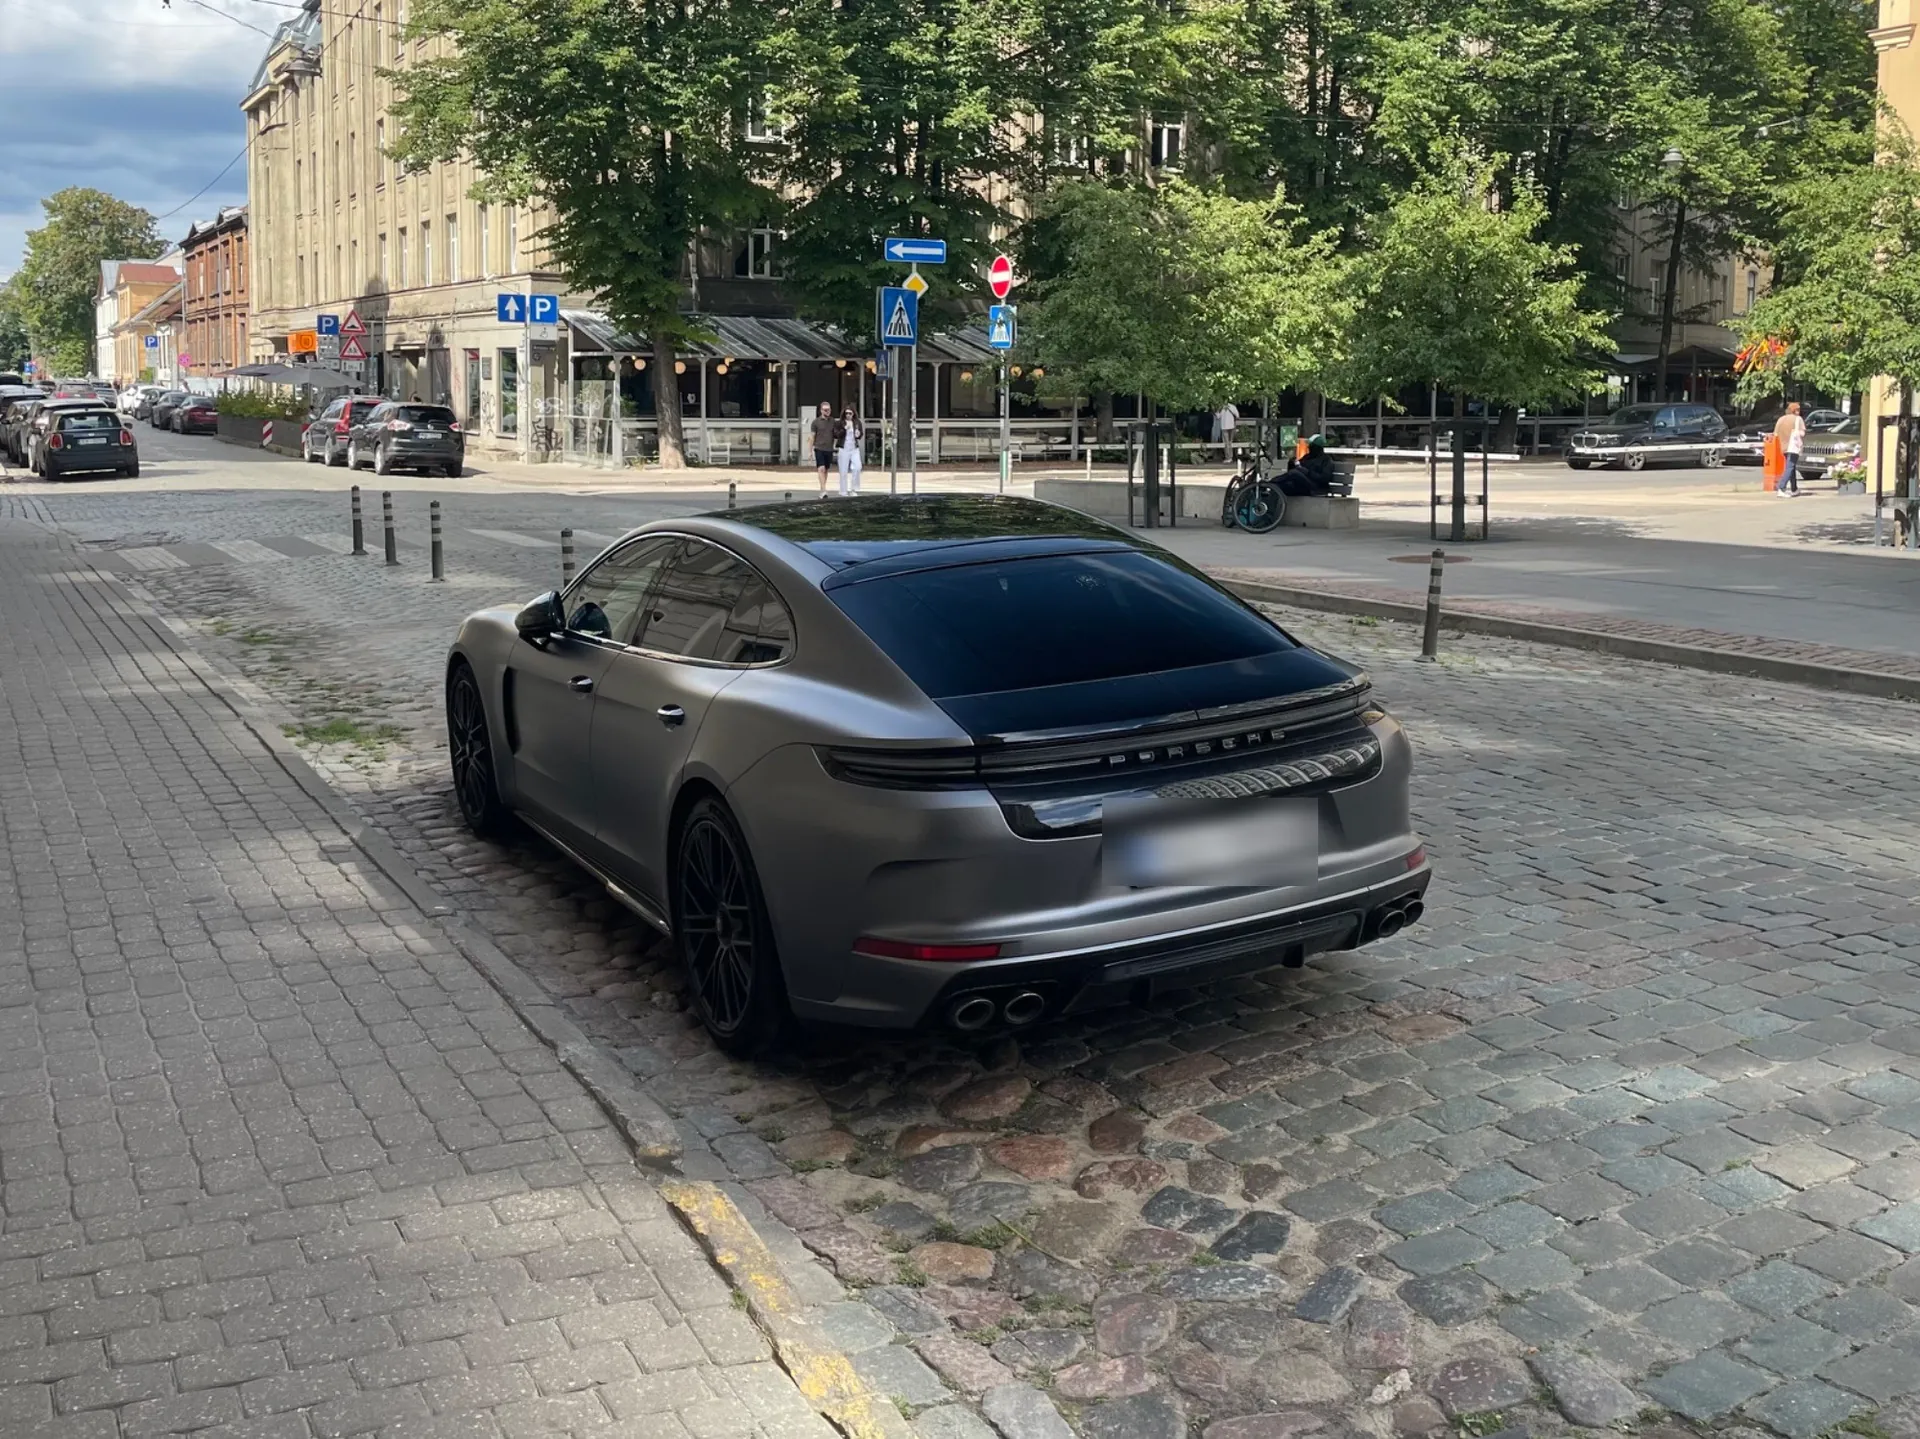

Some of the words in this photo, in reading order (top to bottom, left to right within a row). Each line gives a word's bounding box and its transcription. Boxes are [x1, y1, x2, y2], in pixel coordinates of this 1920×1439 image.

[535, 298, 551, 320] P
[321, 317, 334, 333] P
[1109, 729, 1286, 768] PORSCHE
